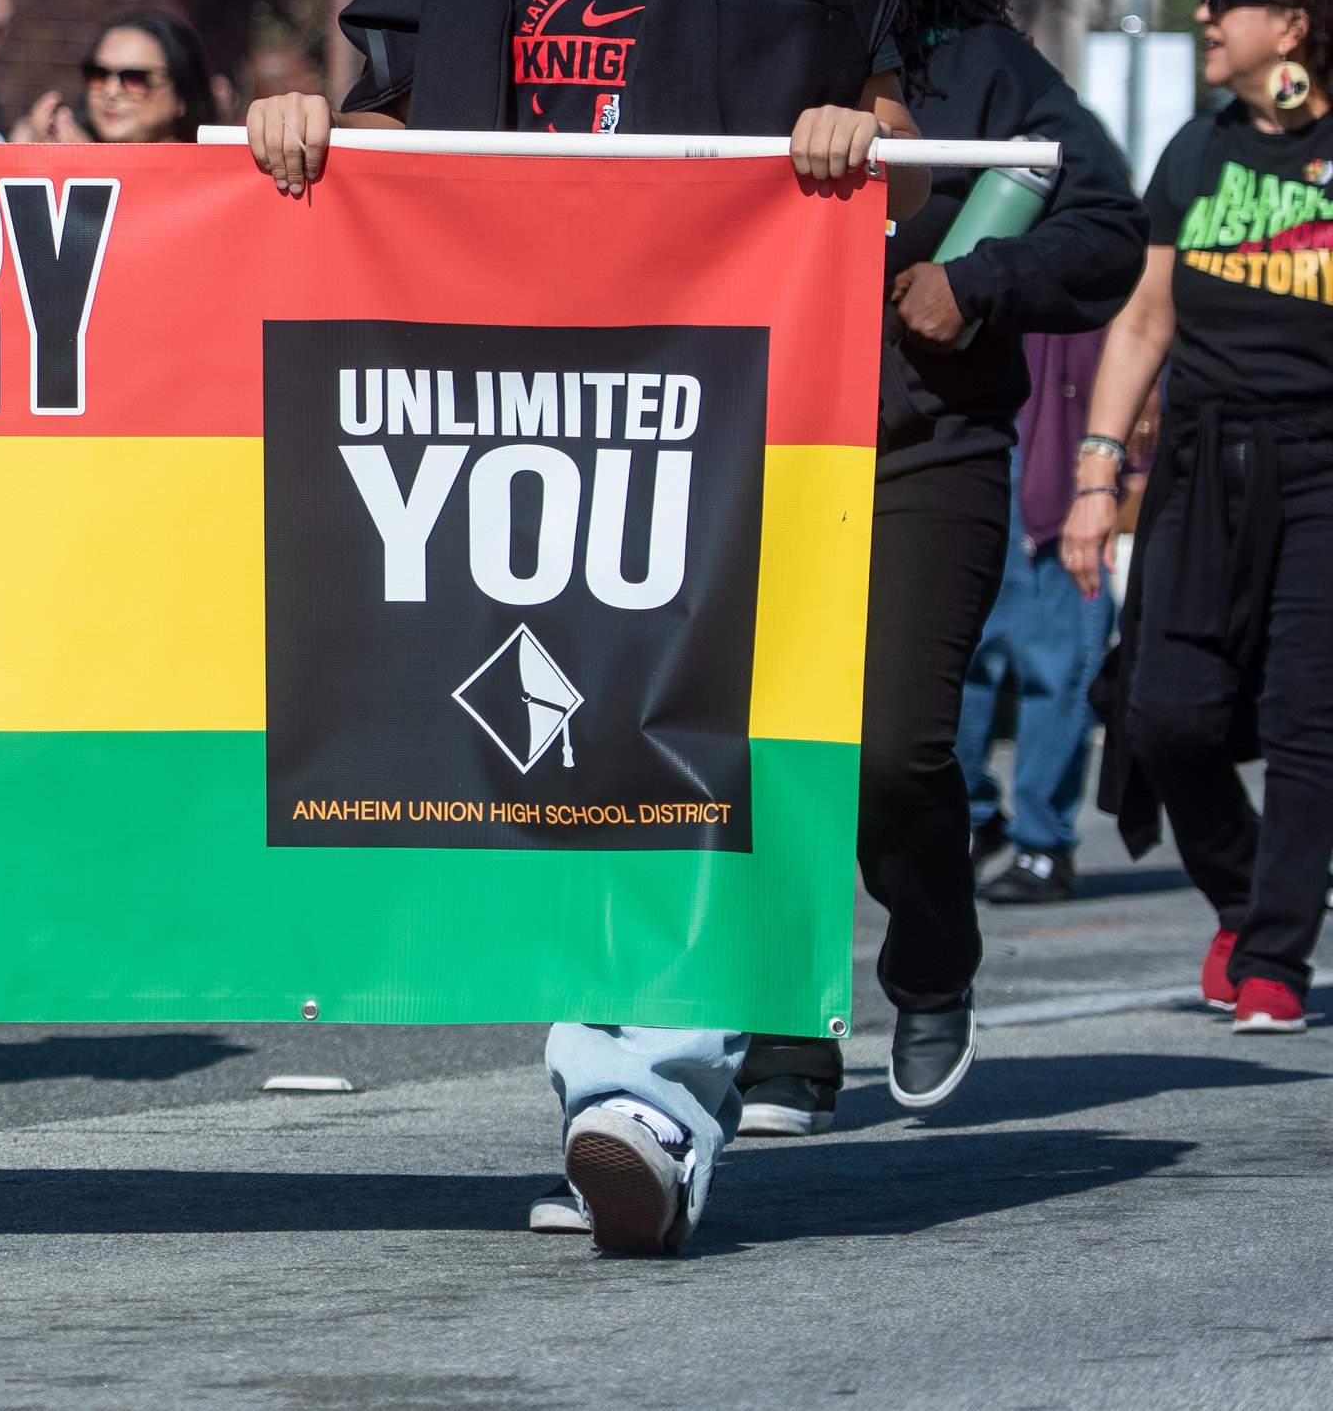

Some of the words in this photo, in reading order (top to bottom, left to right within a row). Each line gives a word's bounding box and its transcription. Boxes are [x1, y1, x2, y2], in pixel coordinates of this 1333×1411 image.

[339, 369, 702, 441] UNLIMITED
[337, 444, 693, 610] YOU
[292, 800, 401, 821] ANAHEIM
[408, 801, 484, 822] UNION
[490, 802, 541, 824] HIGH
[545, 804, 636, 825] SCHOOL
[638, 802, 732, 825] DISTRICT
